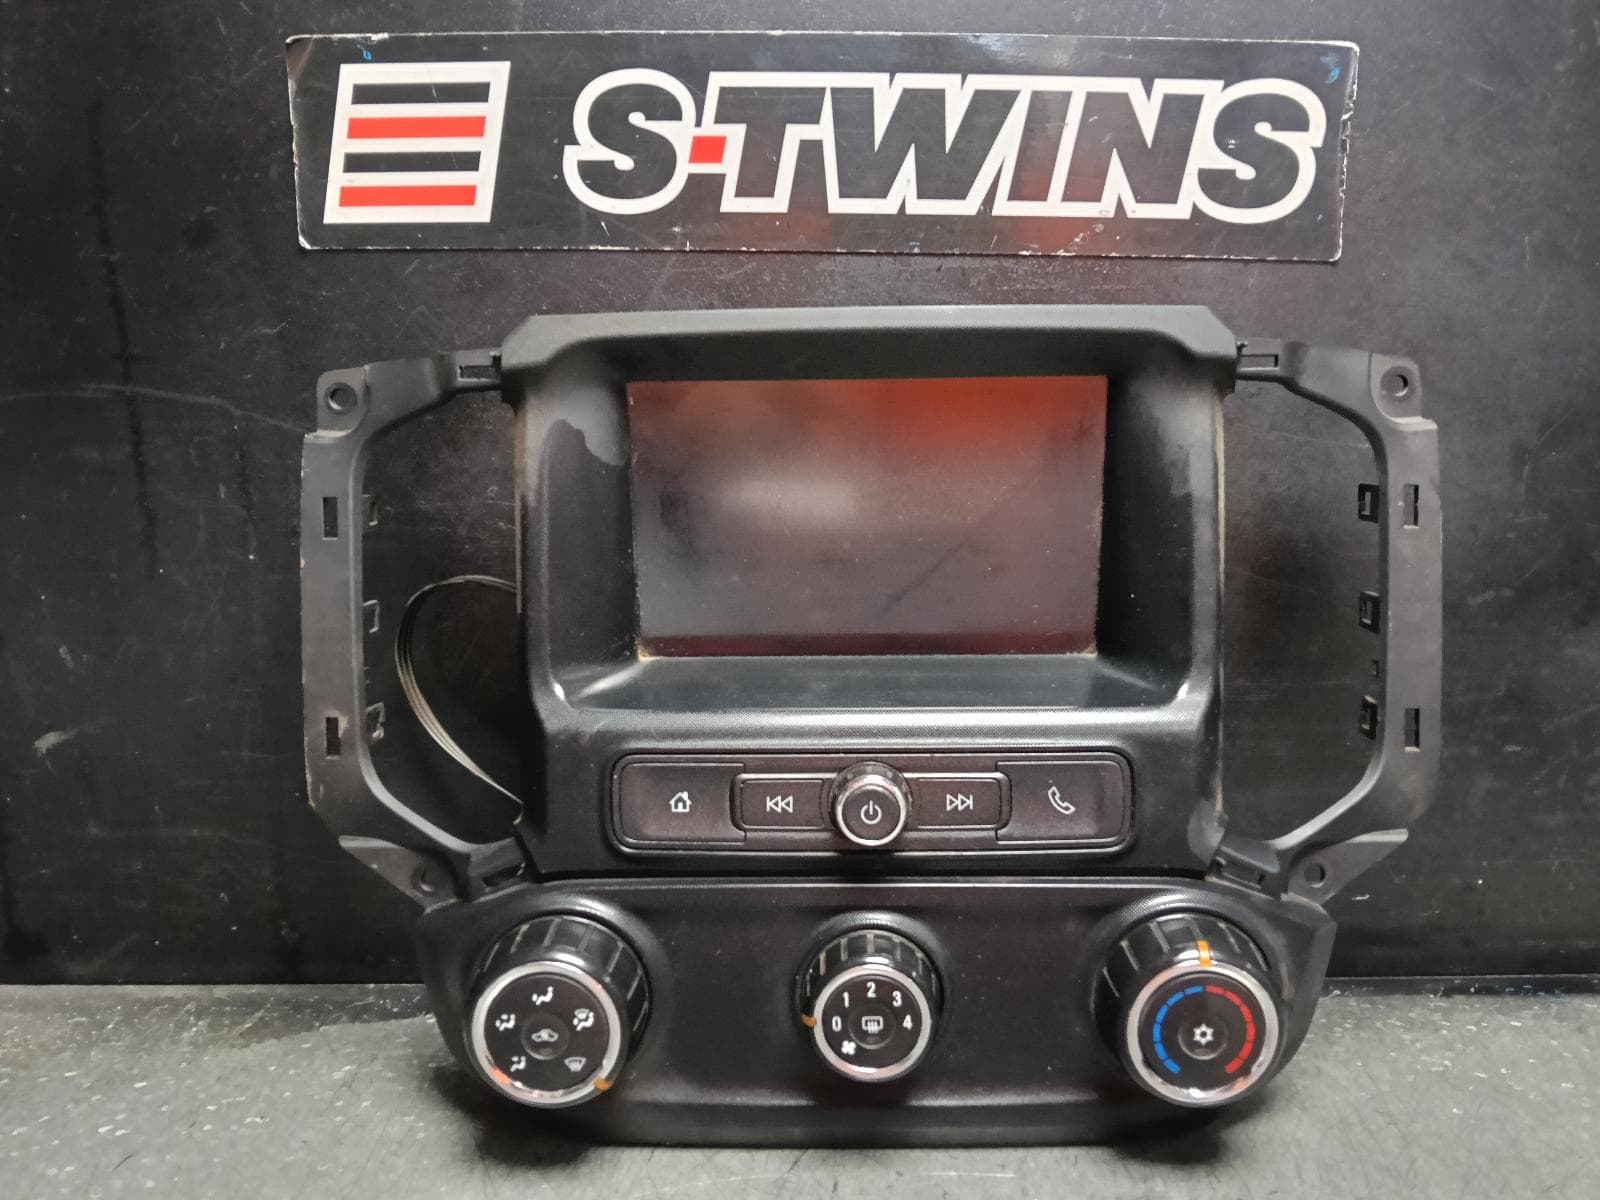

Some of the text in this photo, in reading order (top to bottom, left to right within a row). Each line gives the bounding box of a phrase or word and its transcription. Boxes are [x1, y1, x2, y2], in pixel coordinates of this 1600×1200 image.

[562, 67, 1327, 224] S-TWINS
[831, 981, 913, 1032] 0 1 2 3 4
